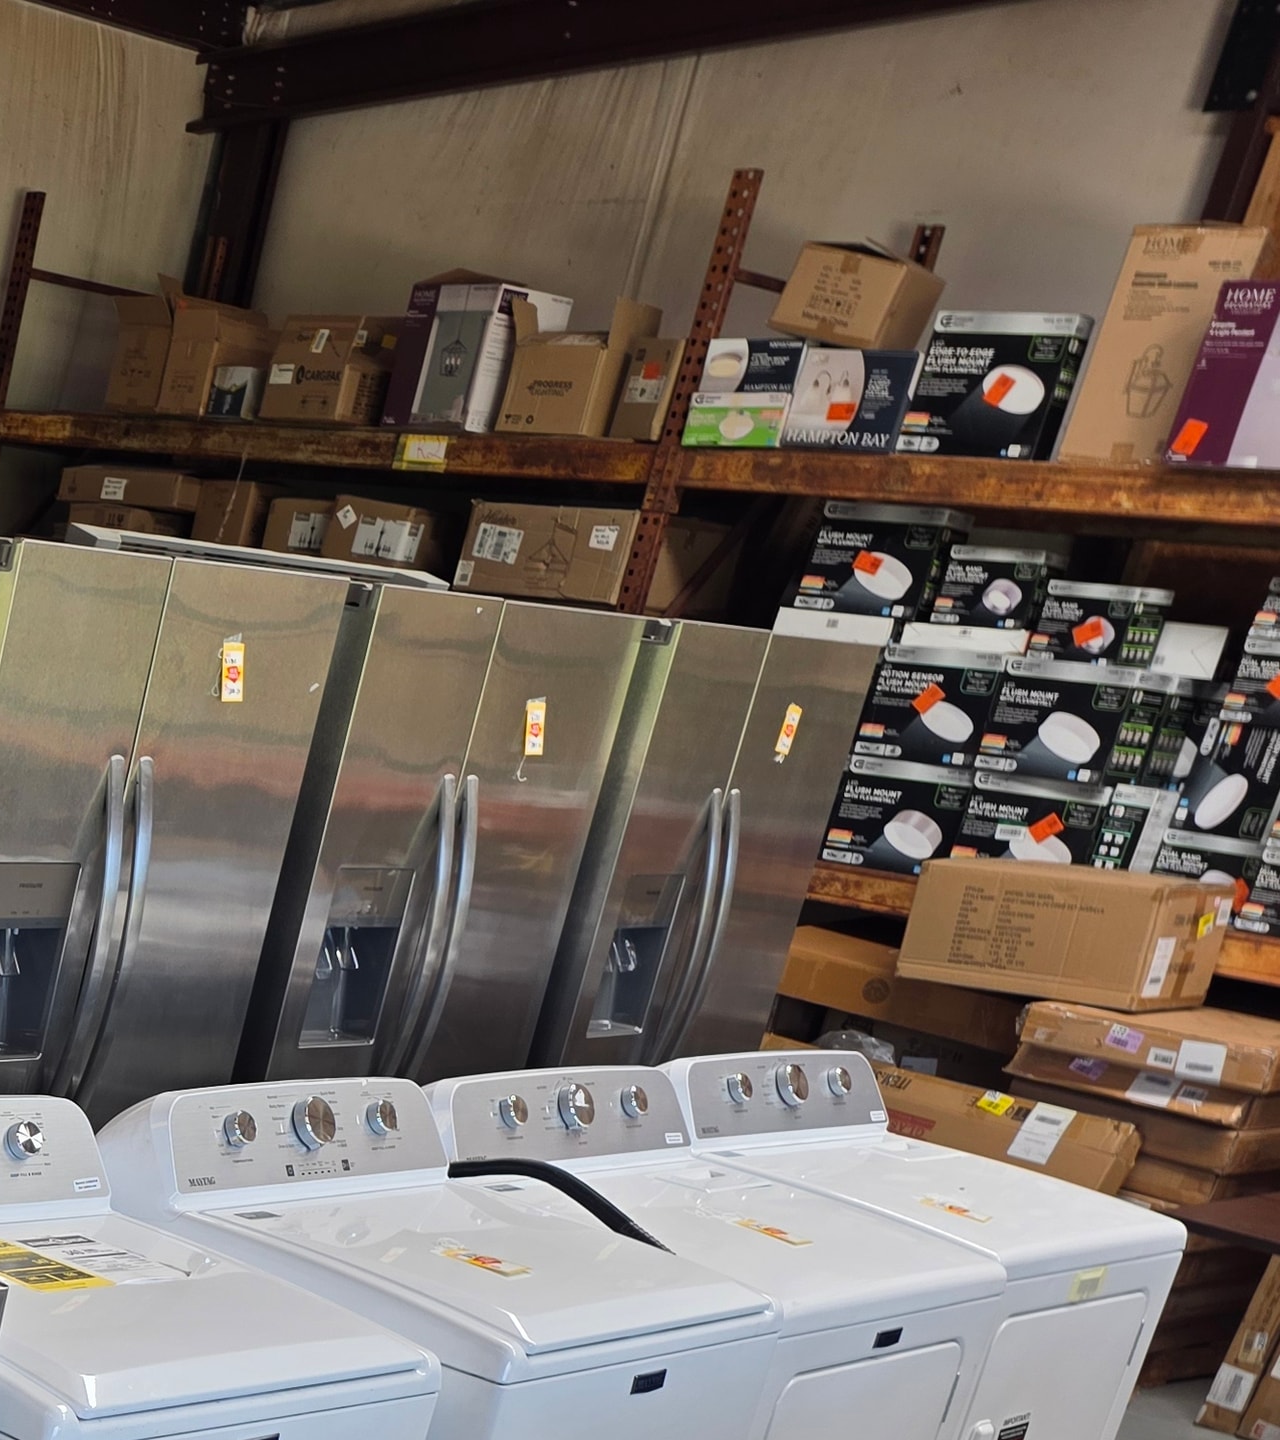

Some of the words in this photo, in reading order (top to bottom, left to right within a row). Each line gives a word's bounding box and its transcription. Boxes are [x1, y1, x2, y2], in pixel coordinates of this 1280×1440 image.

[1226, 289, 1276, 301] HOME
[927, 356, 956, 365] FLUSH
[958, 357, 992, 367] MOUNT
[534, 381, 572, 389] PROGRESS
[787, 428, 860, 446] HAMPTON
[862, 433, 889, 448] BAY
[819, 530, 844, 540] FLUSH
[846, 532, 874, 542] MOUNT
[911, 672, 944, 682] SENSOR
[1001, 687, 1029, 698] FLUSH
[1029, 690, 1060, 701] MOUNT
[845, 785, 872, 795] FLUSH
[873, 787, 902, 799] MOUNT
[969, 800, 997, 811] FLUSH
[999, 804, 1029, 816] MOUNT
[188, 1177, 216, 1187] MAYTAG
